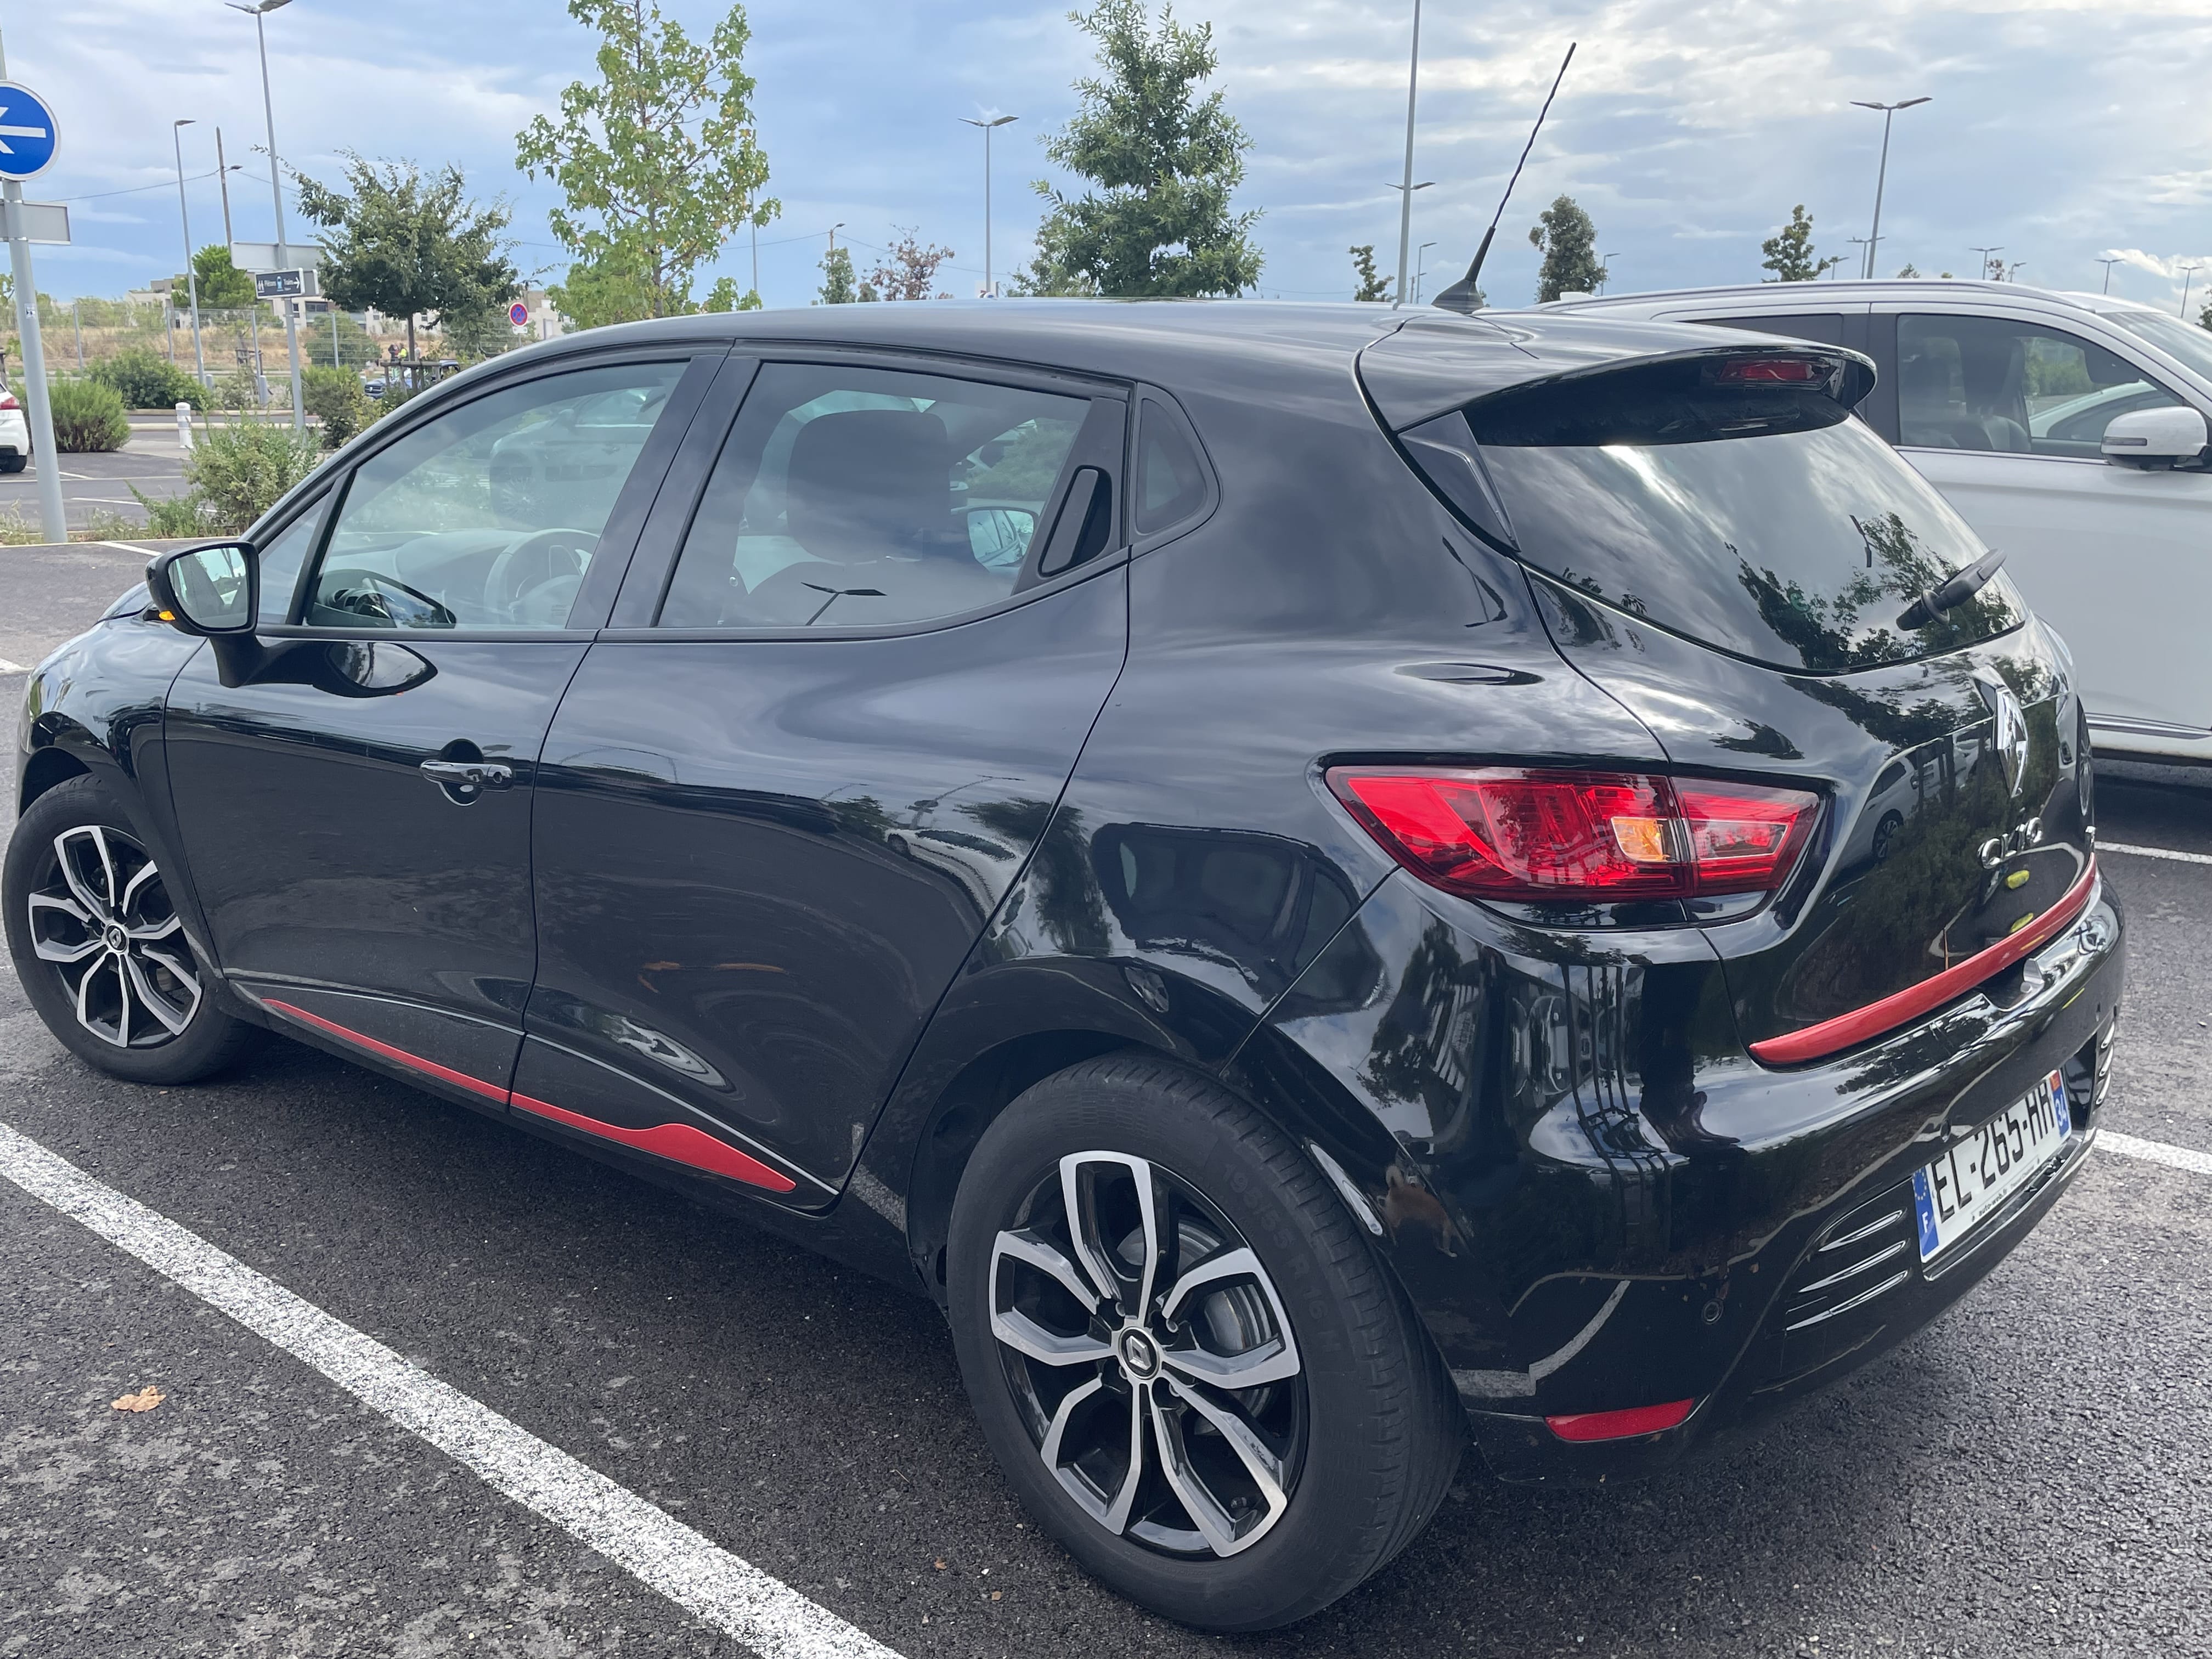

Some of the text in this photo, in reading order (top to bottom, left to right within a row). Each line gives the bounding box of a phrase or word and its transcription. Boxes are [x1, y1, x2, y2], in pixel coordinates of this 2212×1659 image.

[2055, 1094, 2067, 1127] 34
[1921, 1211, 1931, 1233] F
[1303, 1288, 1329, 1319] 16
